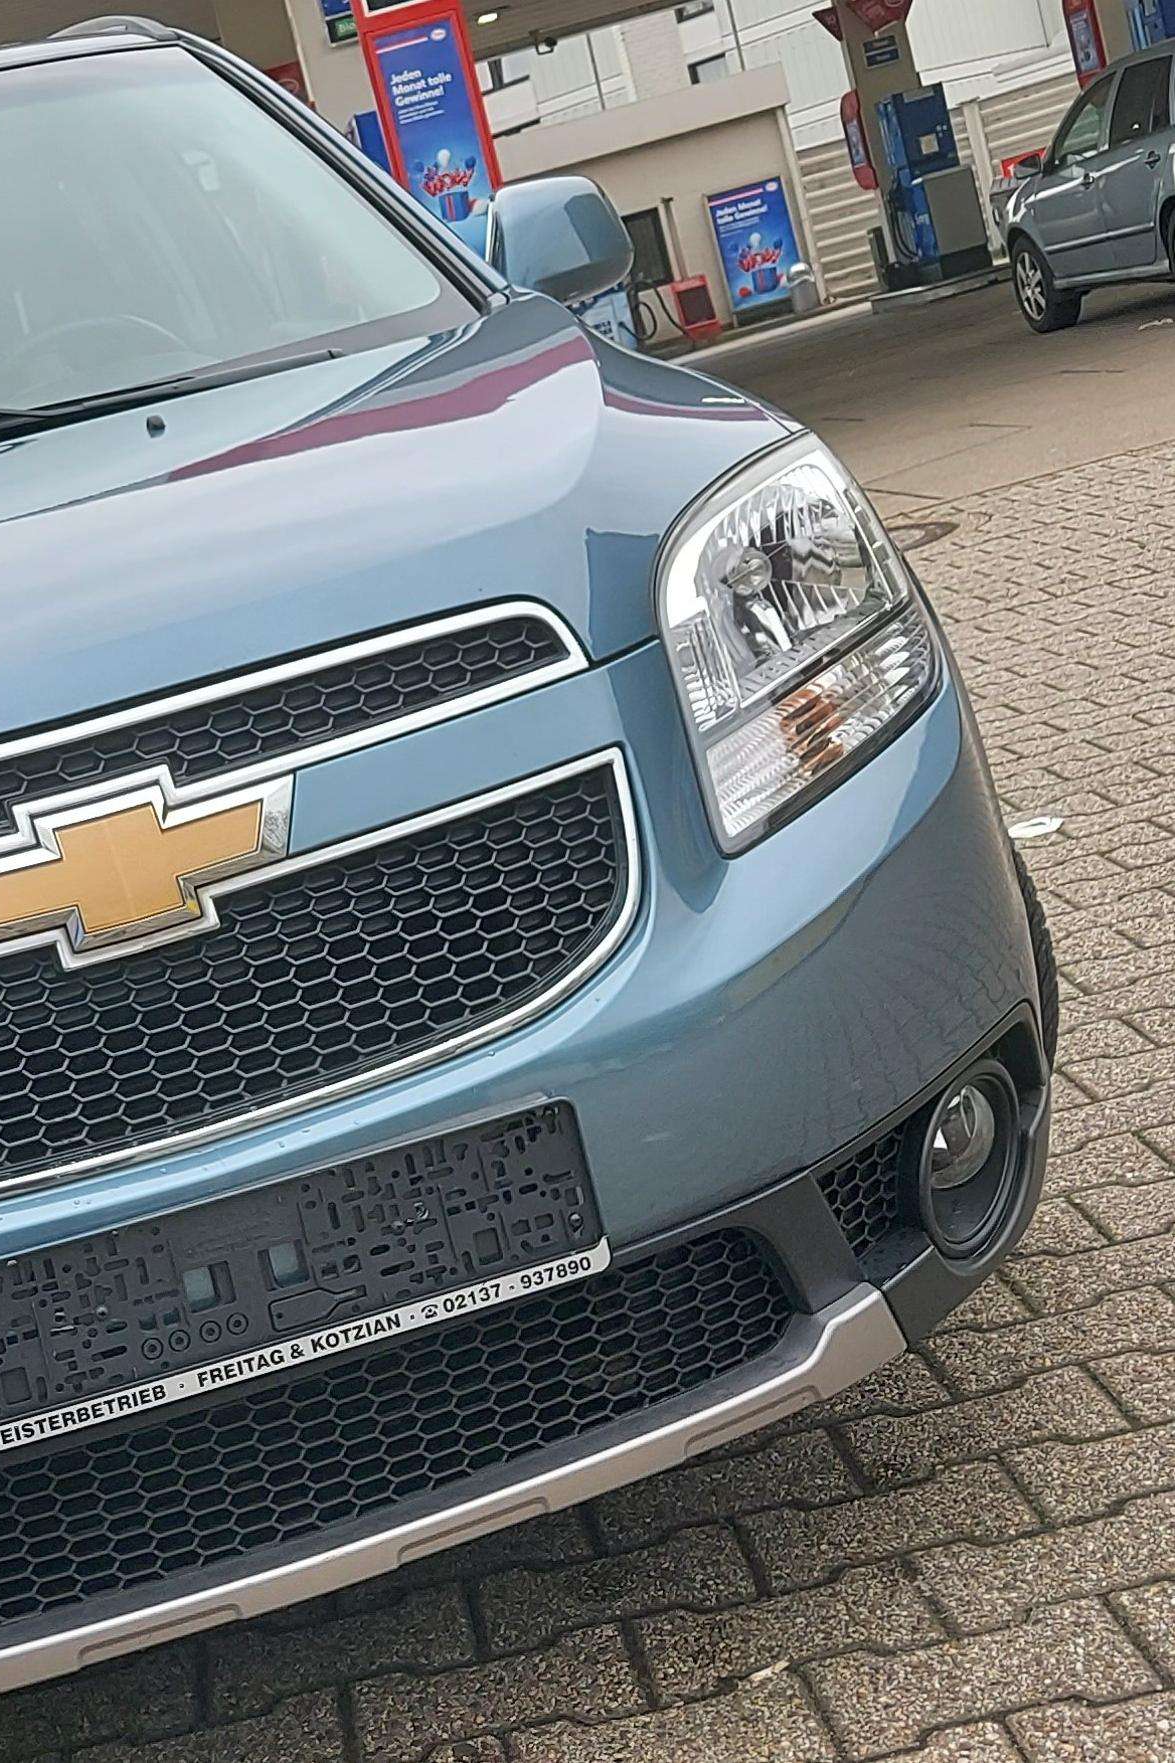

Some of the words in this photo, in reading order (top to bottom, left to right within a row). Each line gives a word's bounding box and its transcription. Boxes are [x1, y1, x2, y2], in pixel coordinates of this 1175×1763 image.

[390, 70, 422, 85] Jeden
[392, 79, 427, 96] Monat
[427, 72, 452, 86] tolle
[395, 85, 445, 107] Gewinne!
[197, 1350, 285, 1387] FREITAG
[290, 1344, 305, 1359] &
[310, 1313, 401, 1353] KOTZIAN
[443, 1284, 501, 1313] 02137
[520, 1257, 591, 1290] 937890
